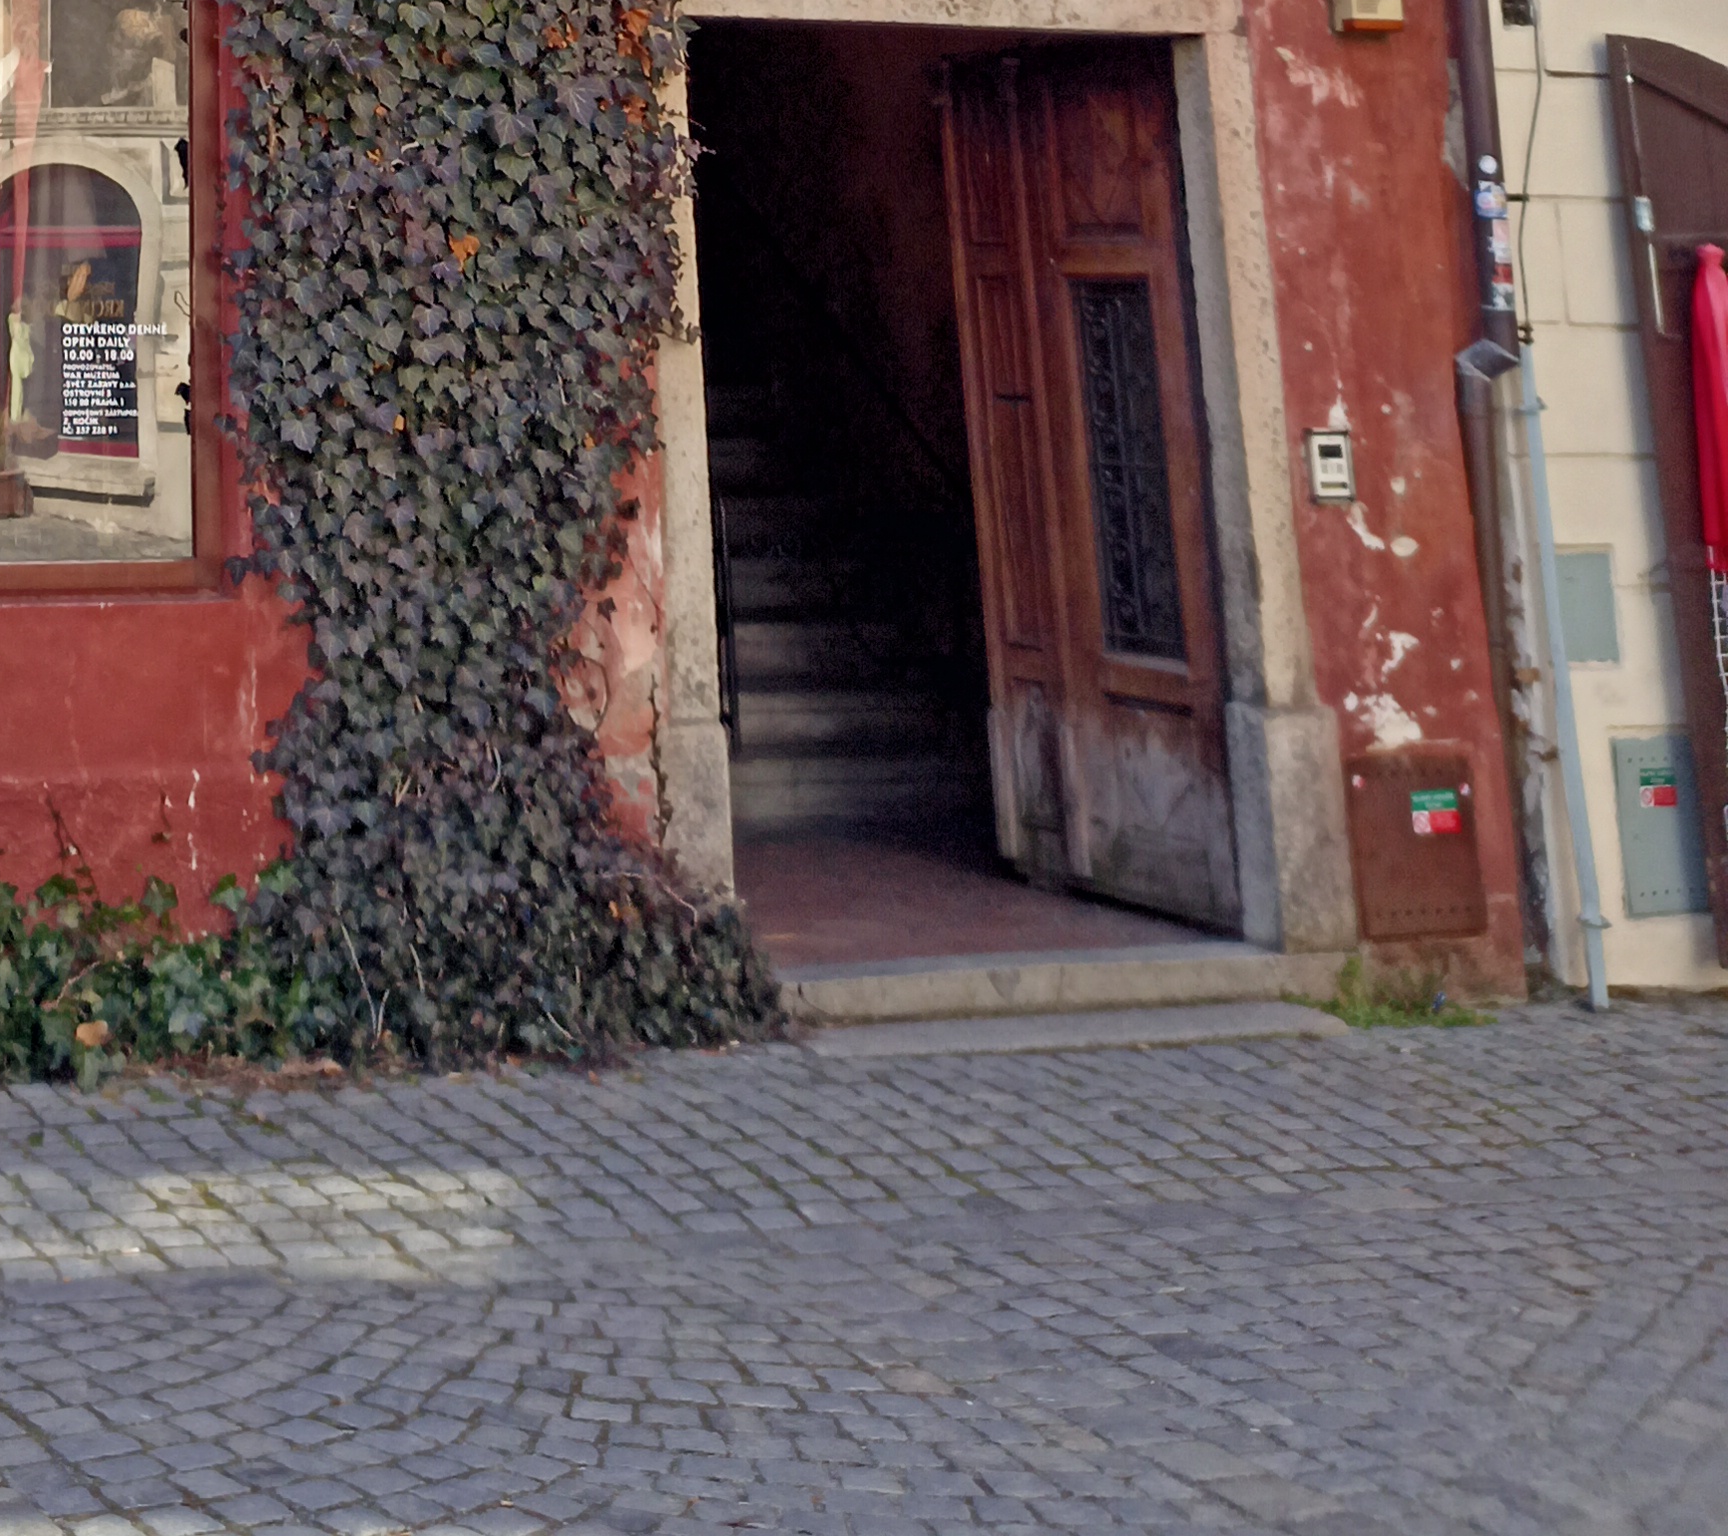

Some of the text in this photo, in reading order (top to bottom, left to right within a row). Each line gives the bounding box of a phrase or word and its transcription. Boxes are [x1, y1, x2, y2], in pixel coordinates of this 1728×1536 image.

[62, 321, 126, 335] OTEVŘENO
[62, 336, 131, 348] OPEN DAILY
[63, 349, 94, 361] 10.00
[104, 349, 134, 361] 18.00
